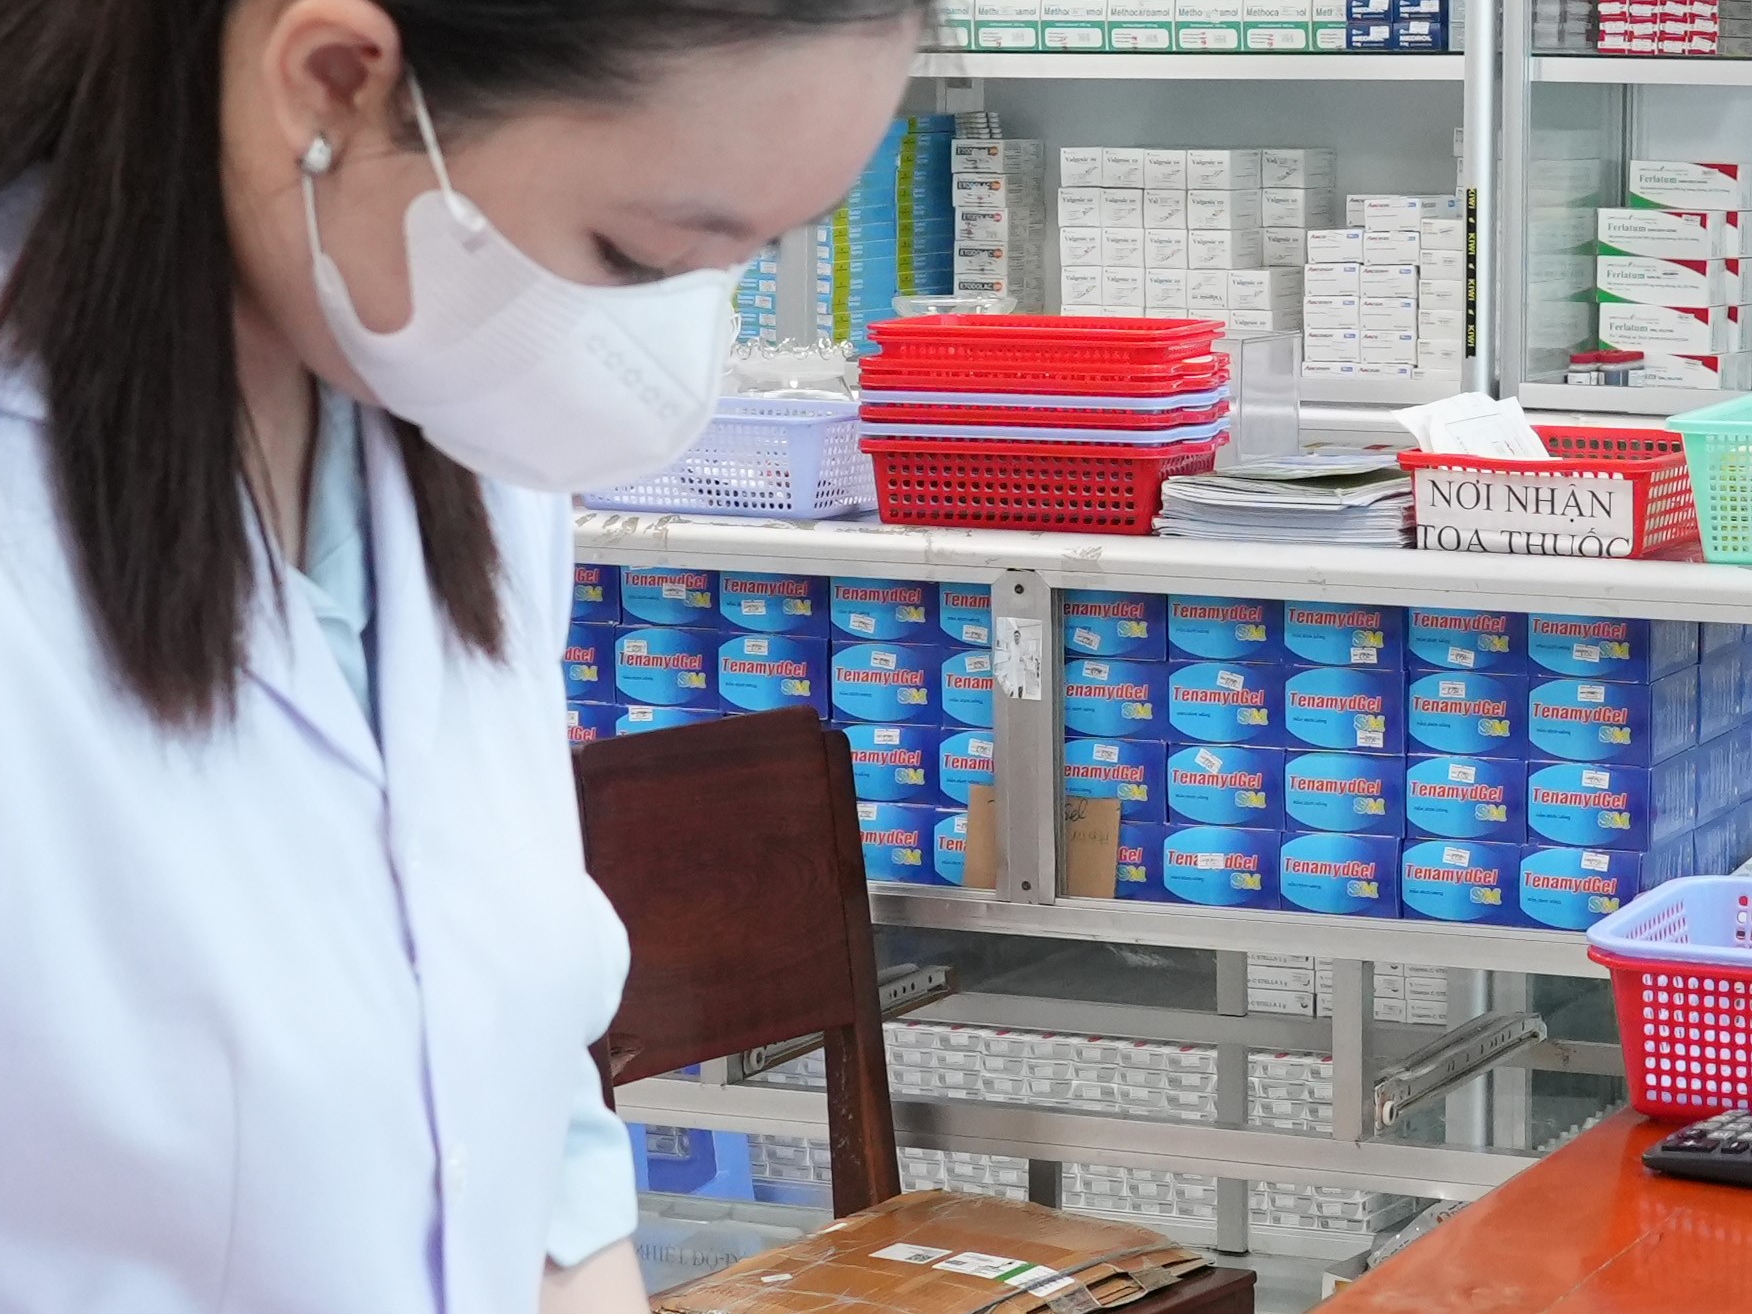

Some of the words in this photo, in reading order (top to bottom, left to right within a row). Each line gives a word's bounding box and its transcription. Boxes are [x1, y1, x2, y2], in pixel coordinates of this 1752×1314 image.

[1639, 174, 1677, 184] Ferlatum
[1608, 222, 1646, 232] Ferlatum
[1607, 270, 1645, 279] Ferlatum
[1429, 479, 1492, 512] NƠI
[1505, 482, 1616, 523] NHẬN
[834, 585, 922, 604] TenamydGel
[721, 659, 807, 678] TenamydGel
[1289, 692, 1381, 714] TenamydGel
[1532, 703, 1627, 725] TenamydGel
[1289, 776, 1382, 796] TenamydGel
[1405, 864, 1498, 885] TenamydGel
